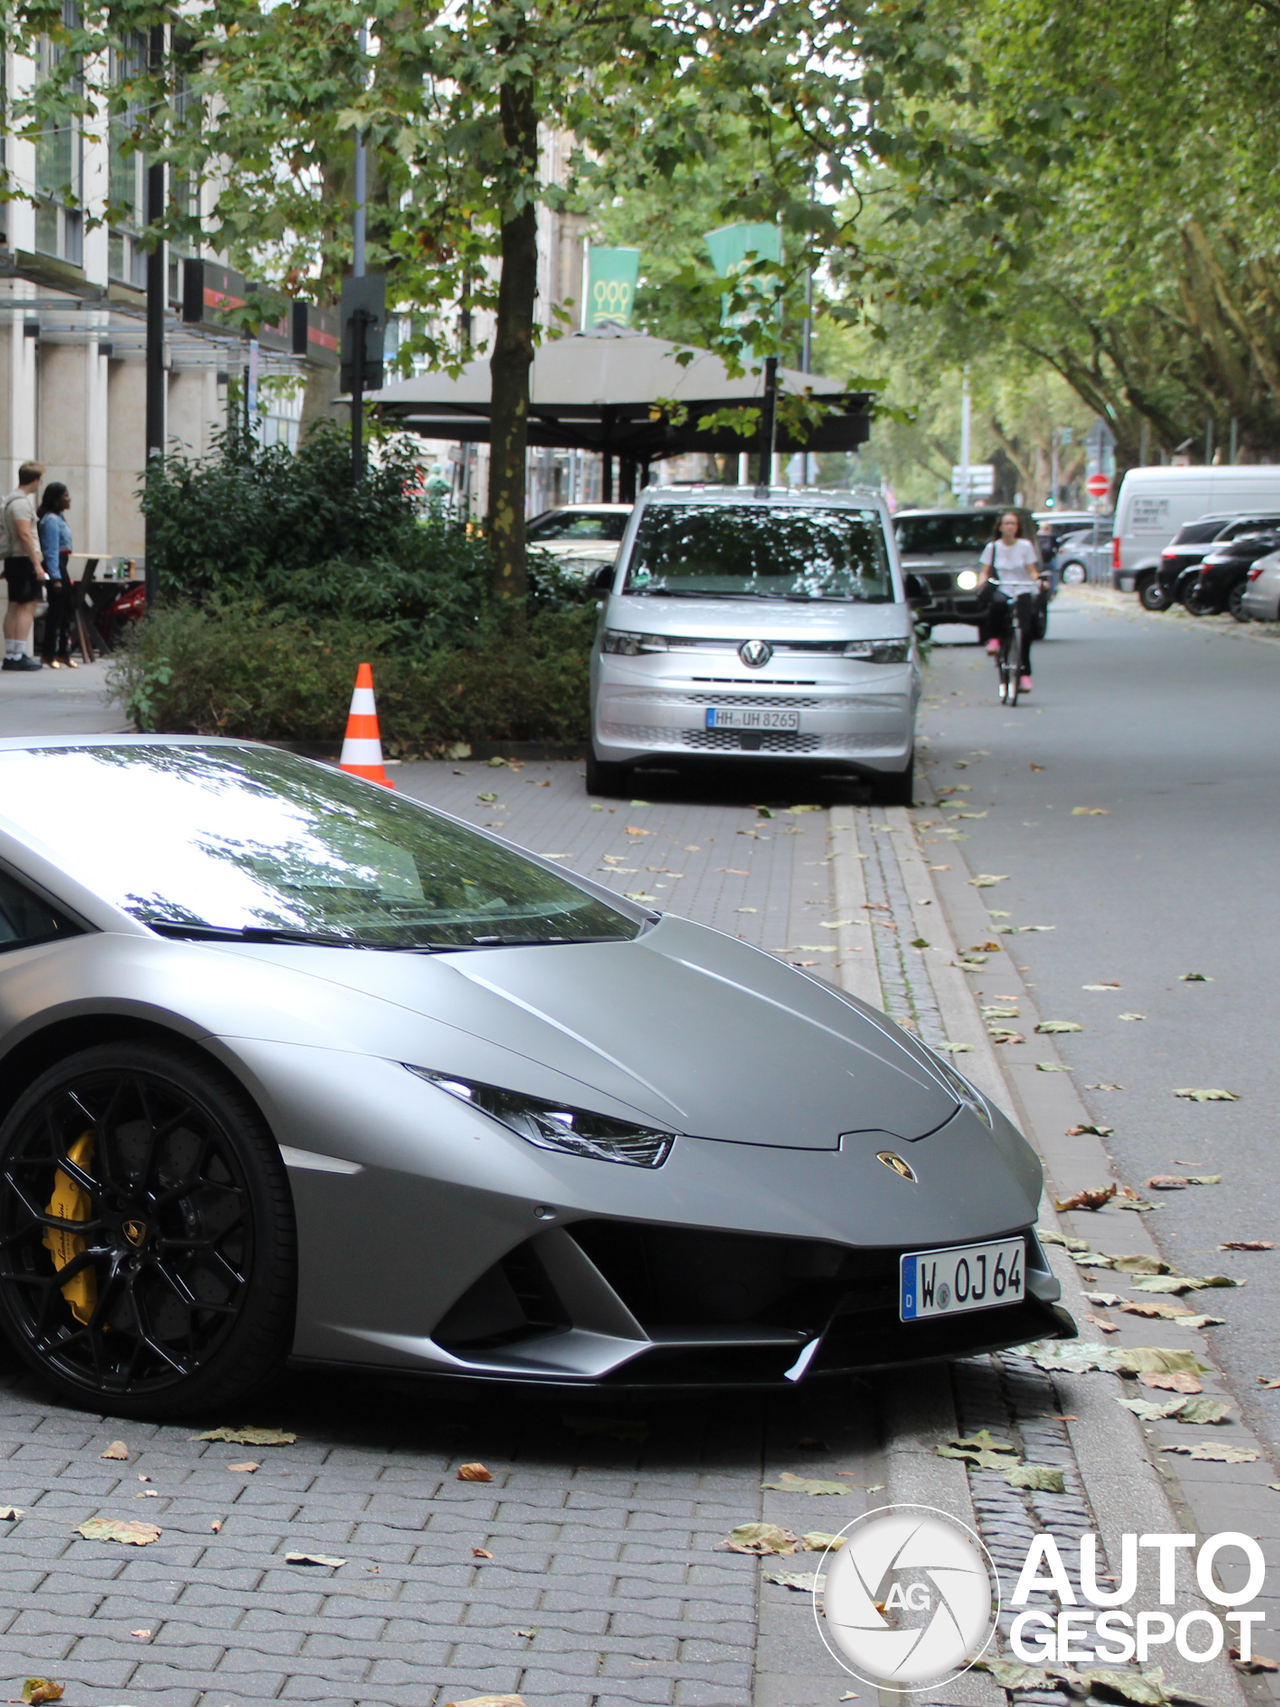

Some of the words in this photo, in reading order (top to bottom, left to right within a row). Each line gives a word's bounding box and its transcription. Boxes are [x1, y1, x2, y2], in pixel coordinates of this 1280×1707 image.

[716, 711, 733, 725] HH
[743, 712, 760, 726] UH
[763, 713, 796, 727] 8265
[921, 1262, 936, 1308] W
[954, 1254, 986, 1302] OJ
[993, 1249, 1020, 1297] 64
[906, 1294, 912, 1307] D
